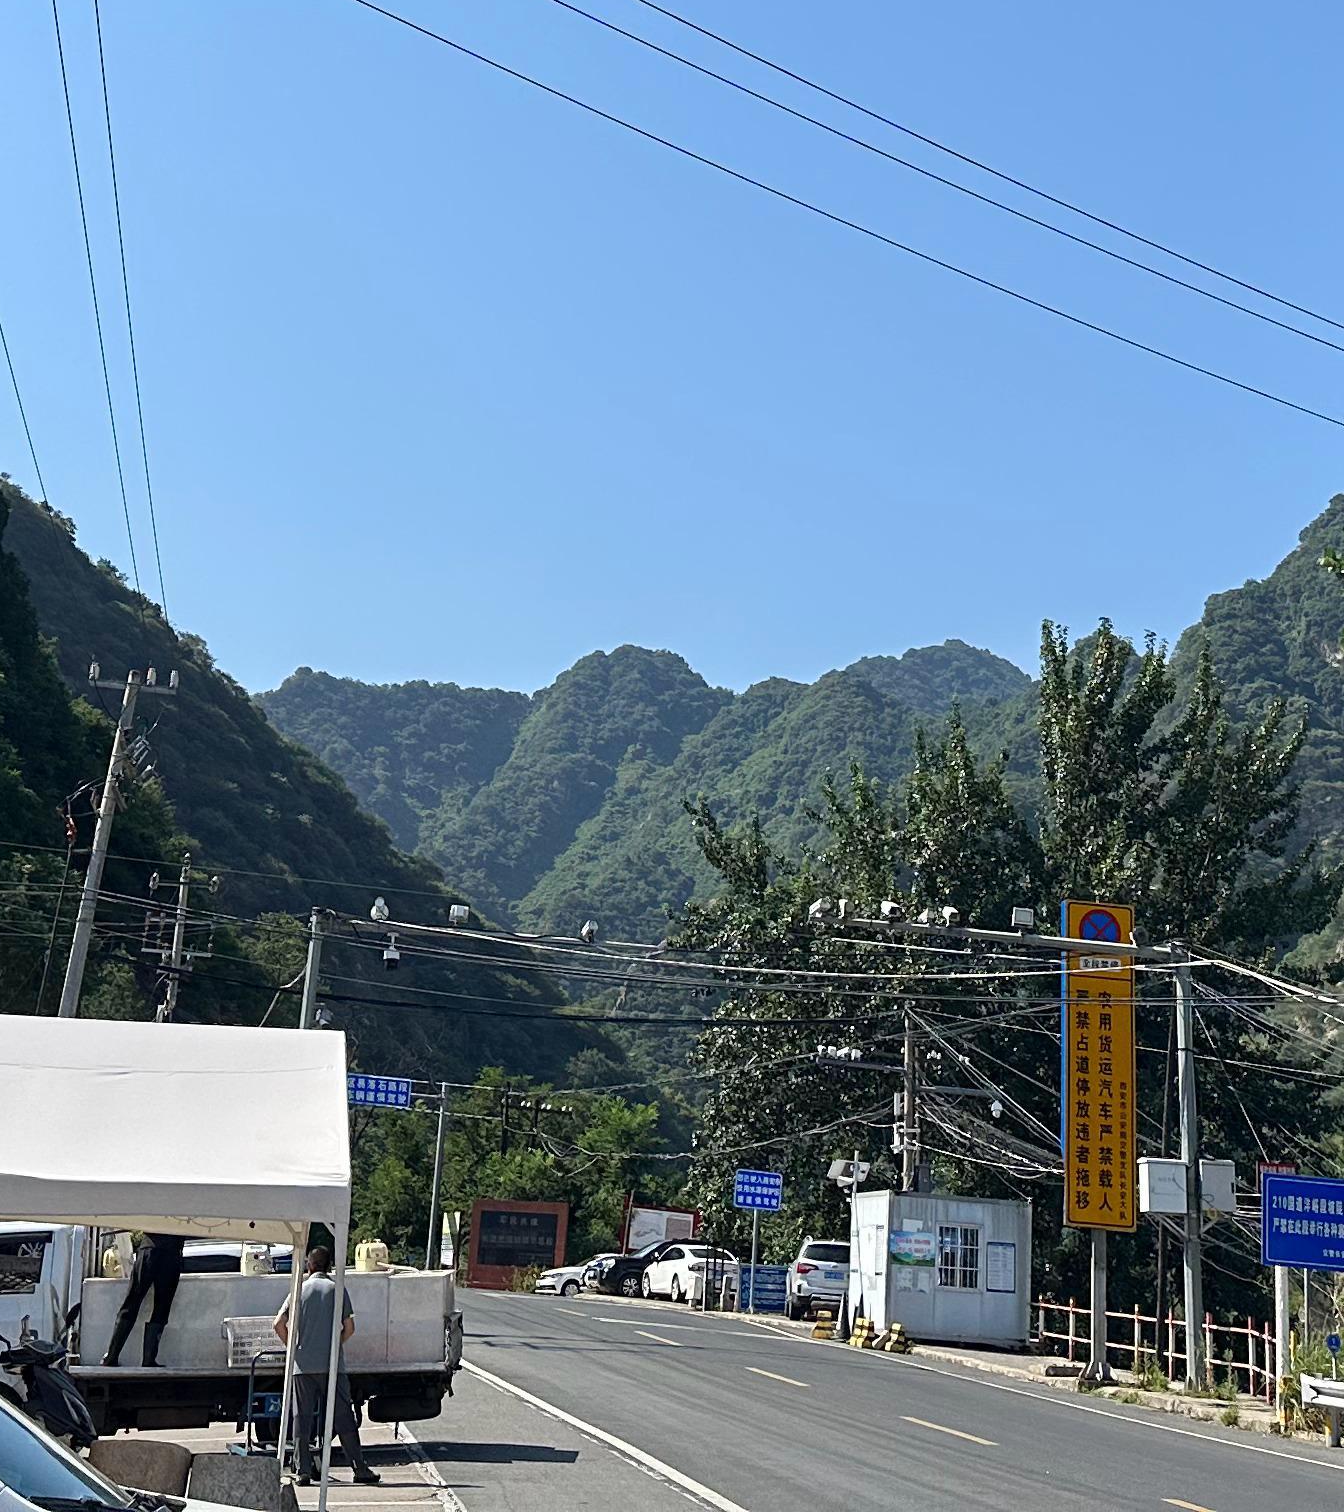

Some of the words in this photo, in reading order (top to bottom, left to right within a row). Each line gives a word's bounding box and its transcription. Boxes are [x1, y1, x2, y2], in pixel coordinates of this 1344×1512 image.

[1098, 990, 1113, 1212] 农用货运汽车严禁载人
